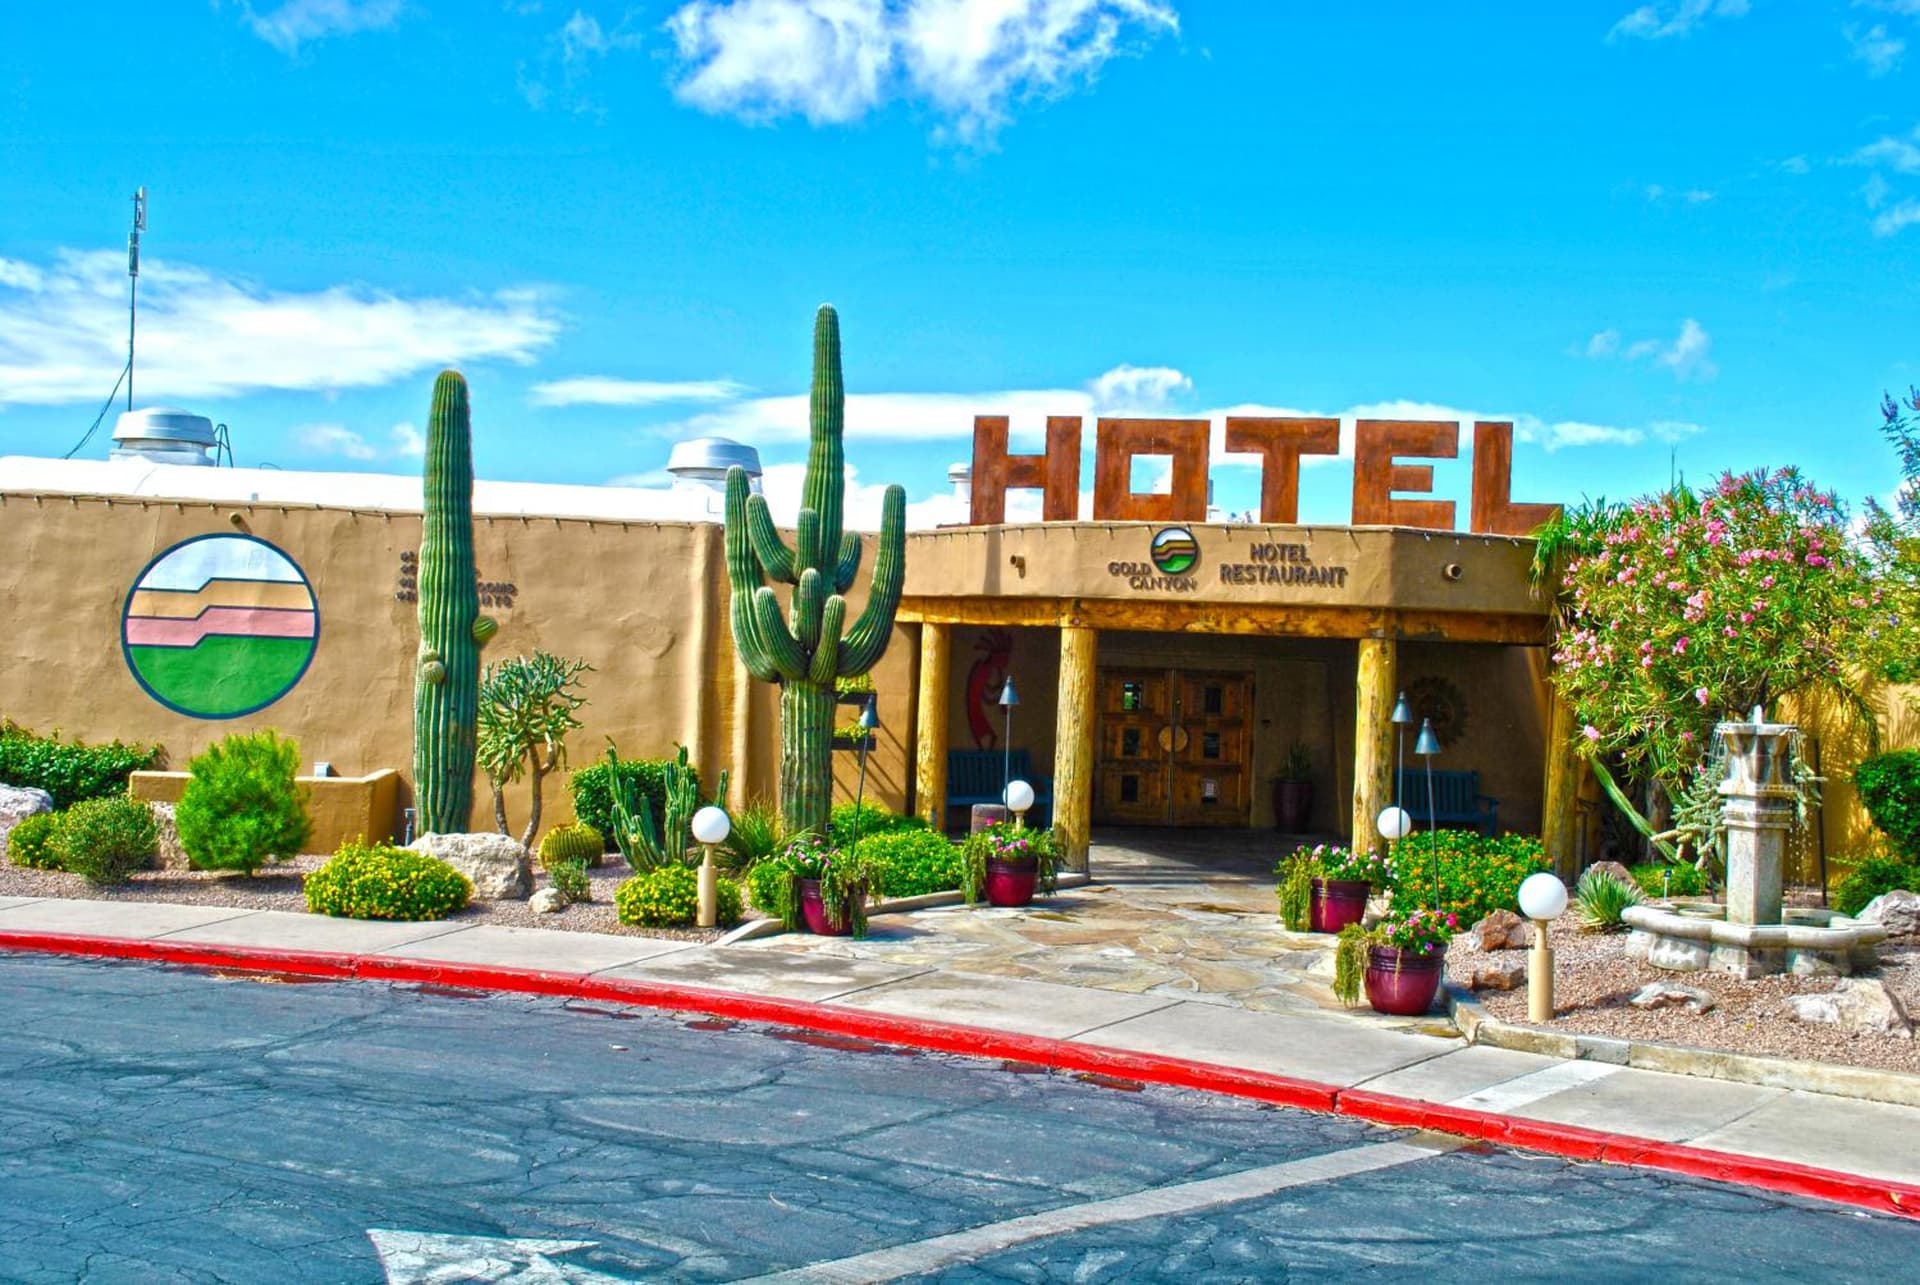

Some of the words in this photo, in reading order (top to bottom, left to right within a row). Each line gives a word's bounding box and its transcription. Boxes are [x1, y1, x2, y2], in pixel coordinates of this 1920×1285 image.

[970, 415, 1564, 537] HOTEL
[1249, 542, 1311, 563] HOTEL
[1107, 562, 1153, 578] GOLD
[1219, 563, 1349, 588] RESTAURANT
[1128, 576, 1198, 592] CANYON
